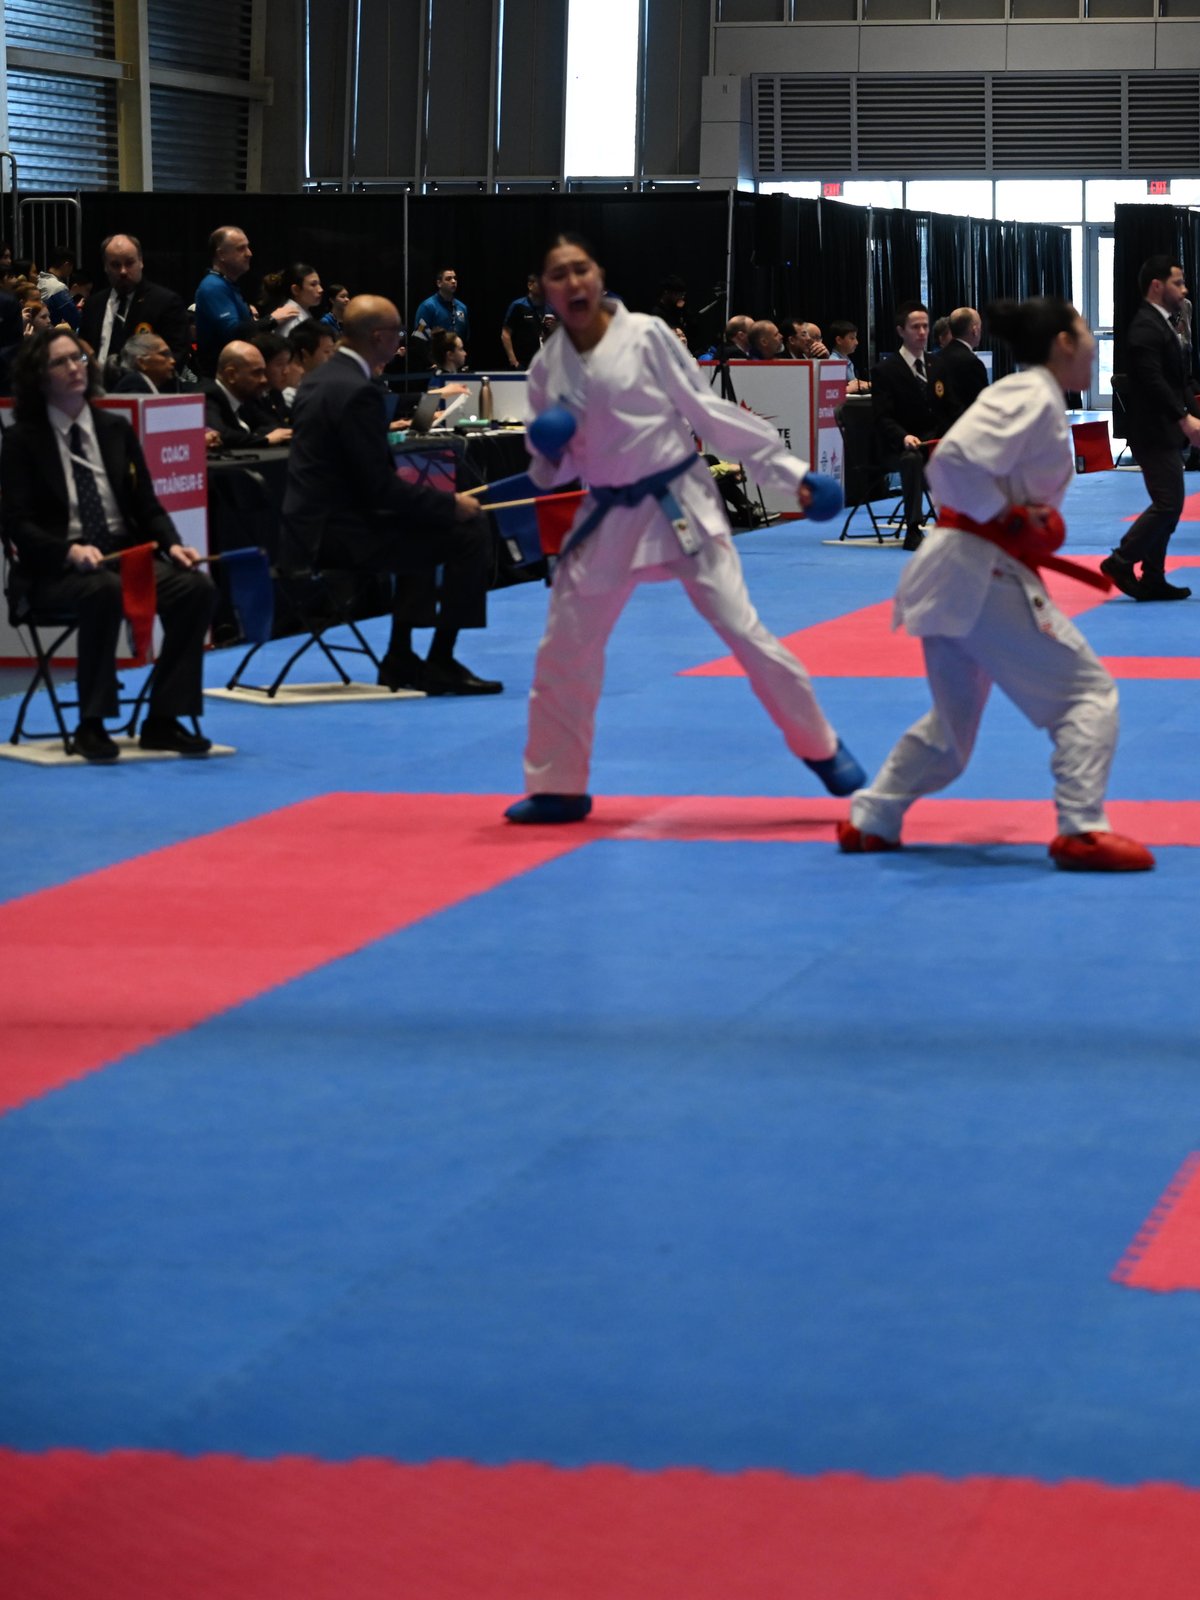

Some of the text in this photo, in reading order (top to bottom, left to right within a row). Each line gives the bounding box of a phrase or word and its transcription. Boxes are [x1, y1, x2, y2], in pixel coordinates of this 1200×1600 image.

[823, 183, 840, 196] EXIT
[1150, 181, 1167, 194] EXIT
[161, 445, 189, 463] COACH
